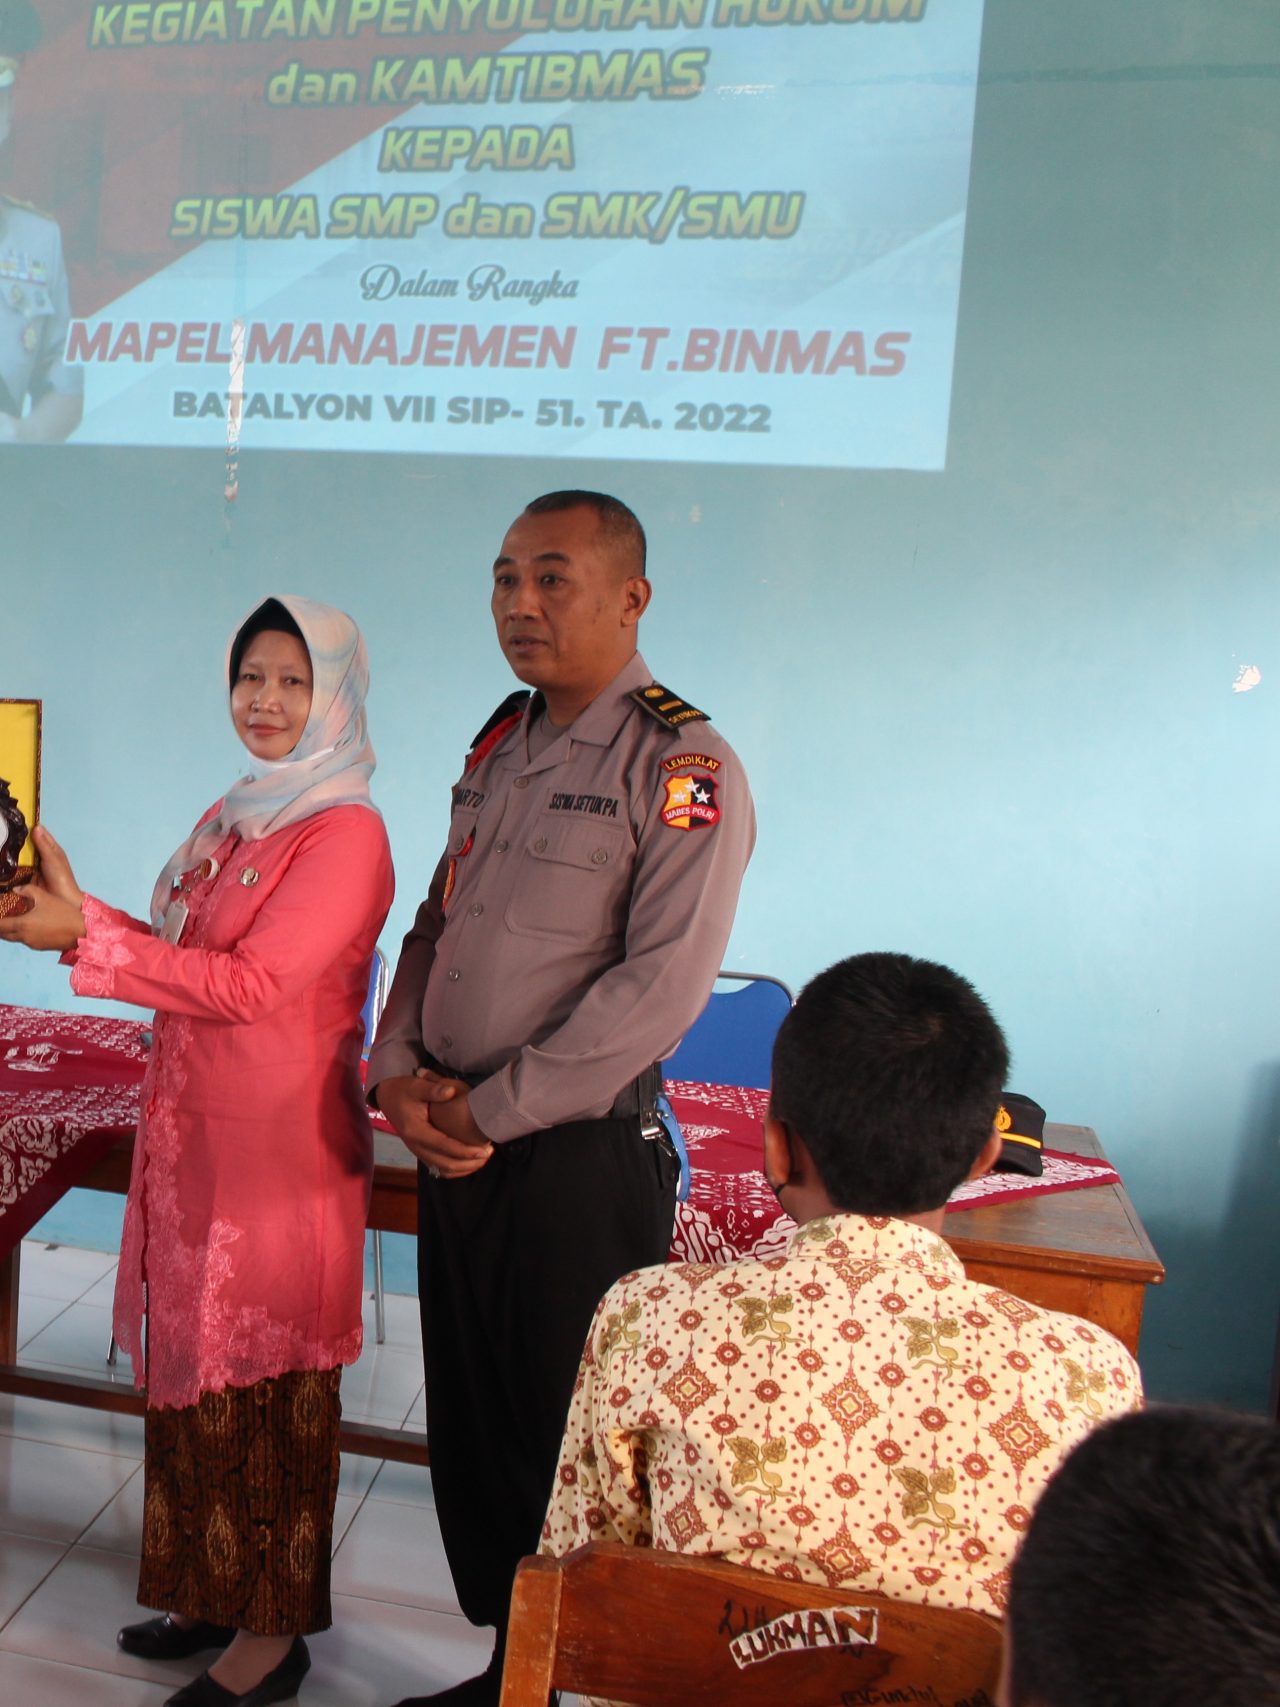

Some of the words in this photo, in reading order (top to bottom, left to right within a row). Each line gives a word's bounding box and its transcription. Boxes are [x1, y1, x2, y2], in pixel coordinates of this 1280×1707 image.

[90, 0, 332, 47] KEGIATAN
[345, 0, 707, 36] PENYULUHAN
[267, 60, 358, 105] dan
[371, 48, 709, 104] KAMTIBMAS
[377, 125, 575, 172] KEPADA
[169, 195, 318, 238] SISWA
[325, 194, 437, 239] SMP
[443, 195, 533, 238] dan
[540, 187, 805, 244] SMK/SMU
[360, 264, 458, 301] Dalam
[467, 264, 579, 306] Rangka
[66, 321, 232, 363] MAPEL
[247, 322, 577, 368] MANAJEMEN
[597, 326, 912, 376] FT.BINMAS
[173, 391, 373, 423] BATALYON
[383, 395, 435, 422] VII
[447, 396, 524, 425] SIP-
[534, 399, 585, 427] 51.
[597, 400, 662, 429] TA.
[674, 402, 772, 432] 2022
[665, 755, 718, 770] LEMDIKLAT
[573, 794, 619, 818] SETUKPA
[665, 807, 690, 820] MABES
[692, 807, 715, 820] POLRI
[729, 1606, 879, 1669] LUKMAN
